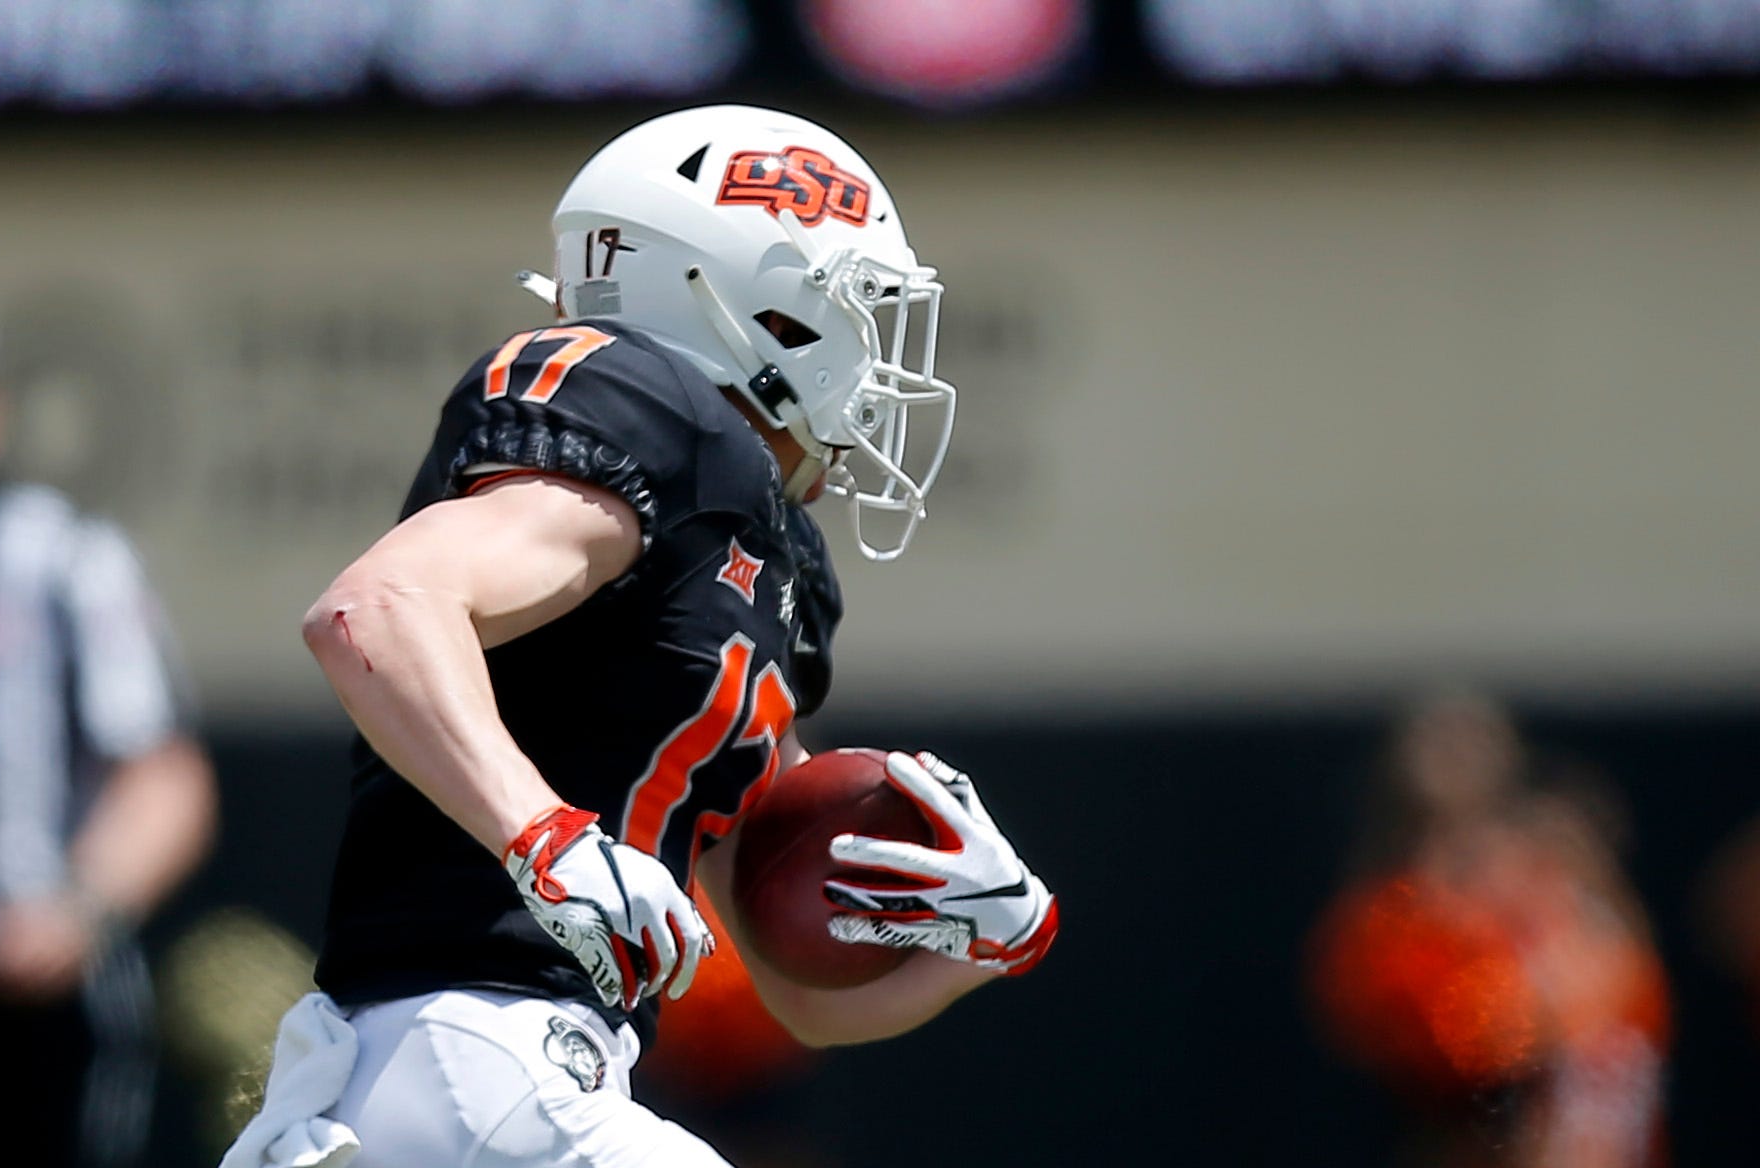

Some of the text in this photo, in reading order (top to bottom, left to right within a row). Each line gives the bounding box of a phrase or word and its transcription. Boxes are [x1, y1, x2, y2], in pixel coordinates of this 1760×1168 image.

[716, 146, 870, 227] OSU
[585, 227, 636, 278] 17
[484, 325, 618, 404] 17
